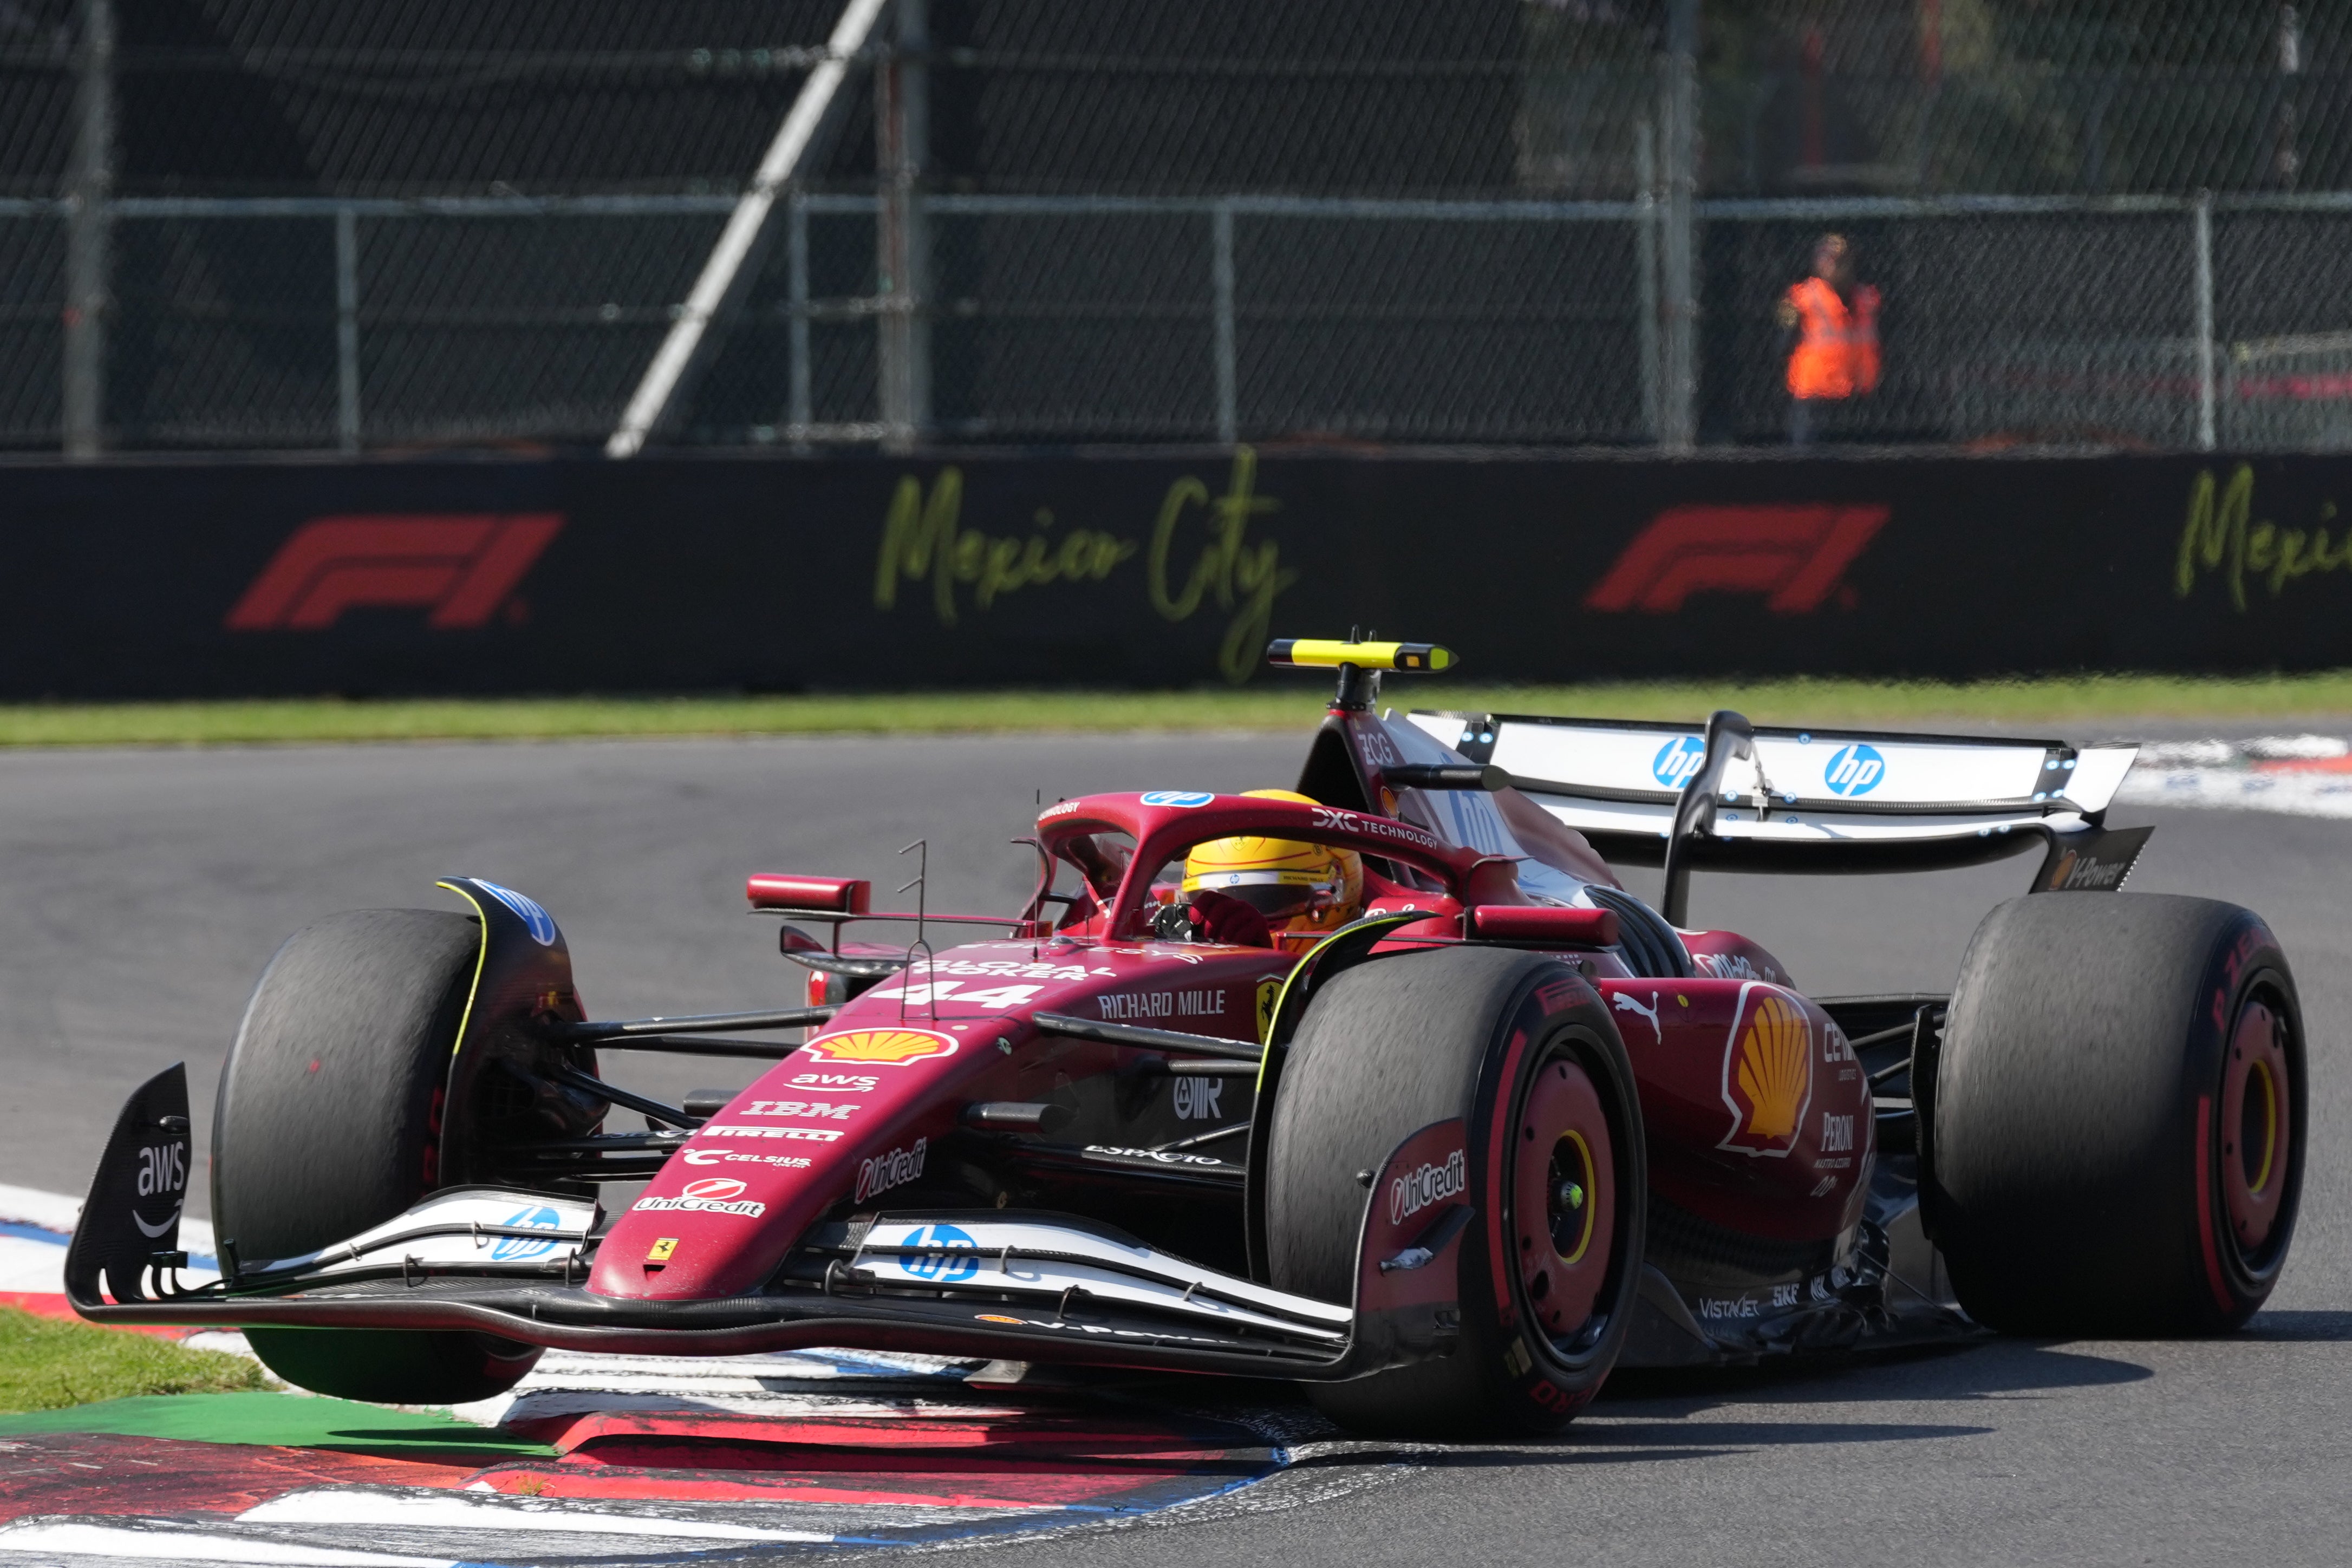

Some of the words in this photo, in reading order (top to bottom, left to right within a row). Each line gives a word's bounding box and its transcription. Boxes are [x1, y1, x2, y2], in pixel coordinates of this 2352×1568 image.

[2174, 464, 2352, 613] Mexi
[874, 466, 1138, 627] Mexico
[1149, 445, 1296, 684] City
[1656, 737, 1705, 788] hp
[1827, 745, 1883, 796] hp
[1311, 807, 1359, 833] DXC
[1361, 821, 1437, 850] TECHNOLOGY
[913, 959, 1117, 977] GLOBAL
[913, 966, 1089, 981] POKER
[868, 981, 1045, 1009] 44
[1097, 991, 1172, 1019] RICHARD
[1178, 990, 1226, 1016] MILLE
[791, 1074, 880, 1086] aws
[739, 1101, 862, 1120] IBM
[701, 1126, 845, 1141] PIRELLI
[1820, 1112, 1854, 1152] PERONI
[138, 1141, 185, 1197] aws
[724, 1154, 812, 1166] CELSIUS
[868, 1138, 927, 1197] UniCredit
[1402, 1149, 1464, 1218] UniCredit
[633, 1197, 766, 1217] UniCredit
[493, 1207, 559, 1260] hp
[903, 1225, 977, 1282] hp
[1773, 1283, 1800, 1307] SKF
